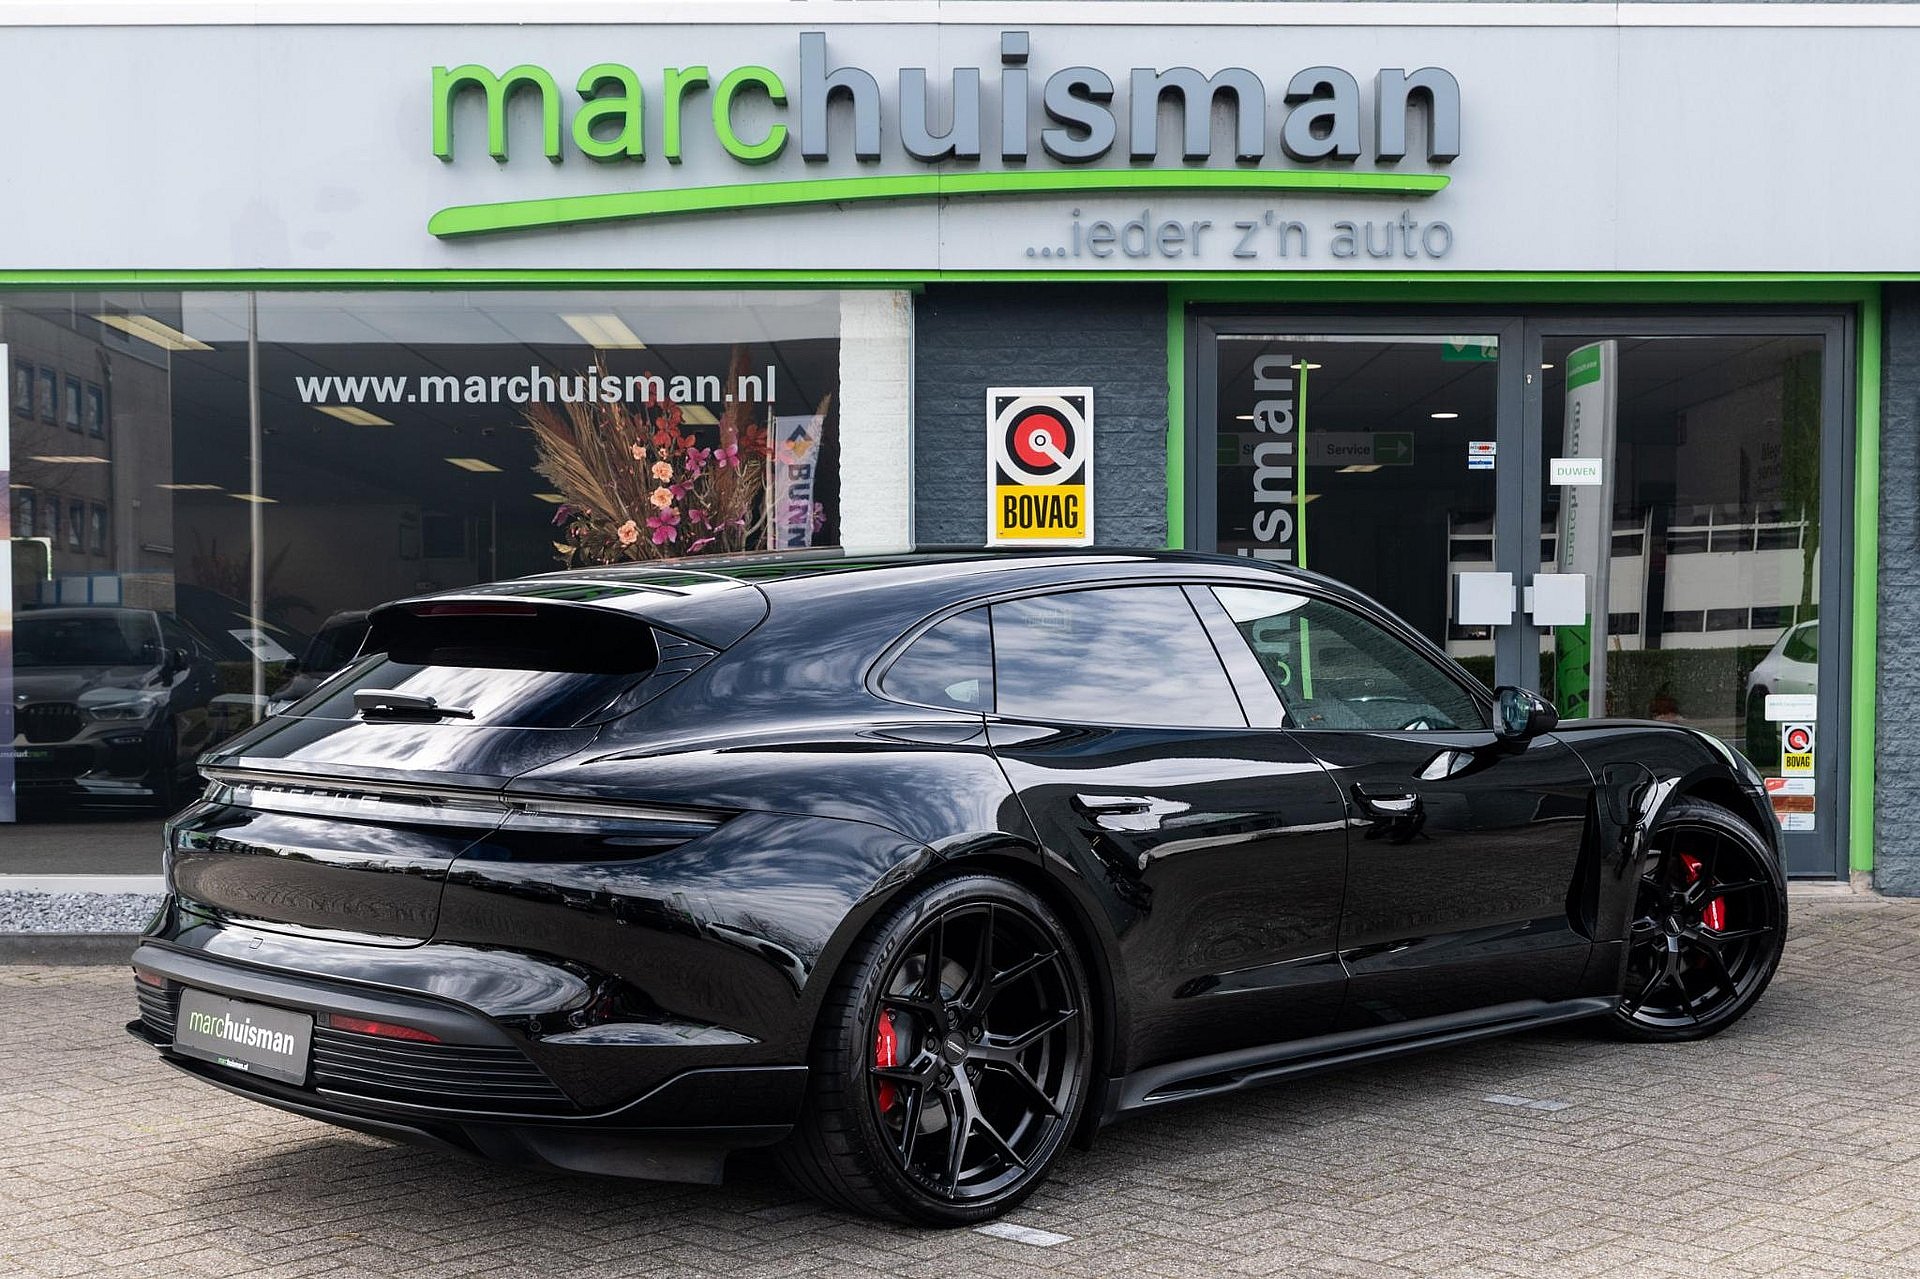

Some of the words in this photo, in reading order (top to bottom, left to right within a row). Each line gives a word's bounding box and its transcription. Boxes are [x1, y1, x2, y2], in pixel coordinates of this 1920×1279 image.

[431, 31, 1461, 165] marchuisman
[1025, 208, 1211, 258] ...ieder
[1232, 209, 1308, 258] z'n
[1330, 208, 1453, 258] auto
[295, 365, 776, 403] www.marchuisman.nl
[1327, 443, 1371, 456] Service
[1557, 466, 1596, 476] DUWEN
[1003, 494, 1079, 529] BOVAG
[1786, 756, 1811, 768] BOVAG
[189, 1011, 295, 1056] marchuisman
